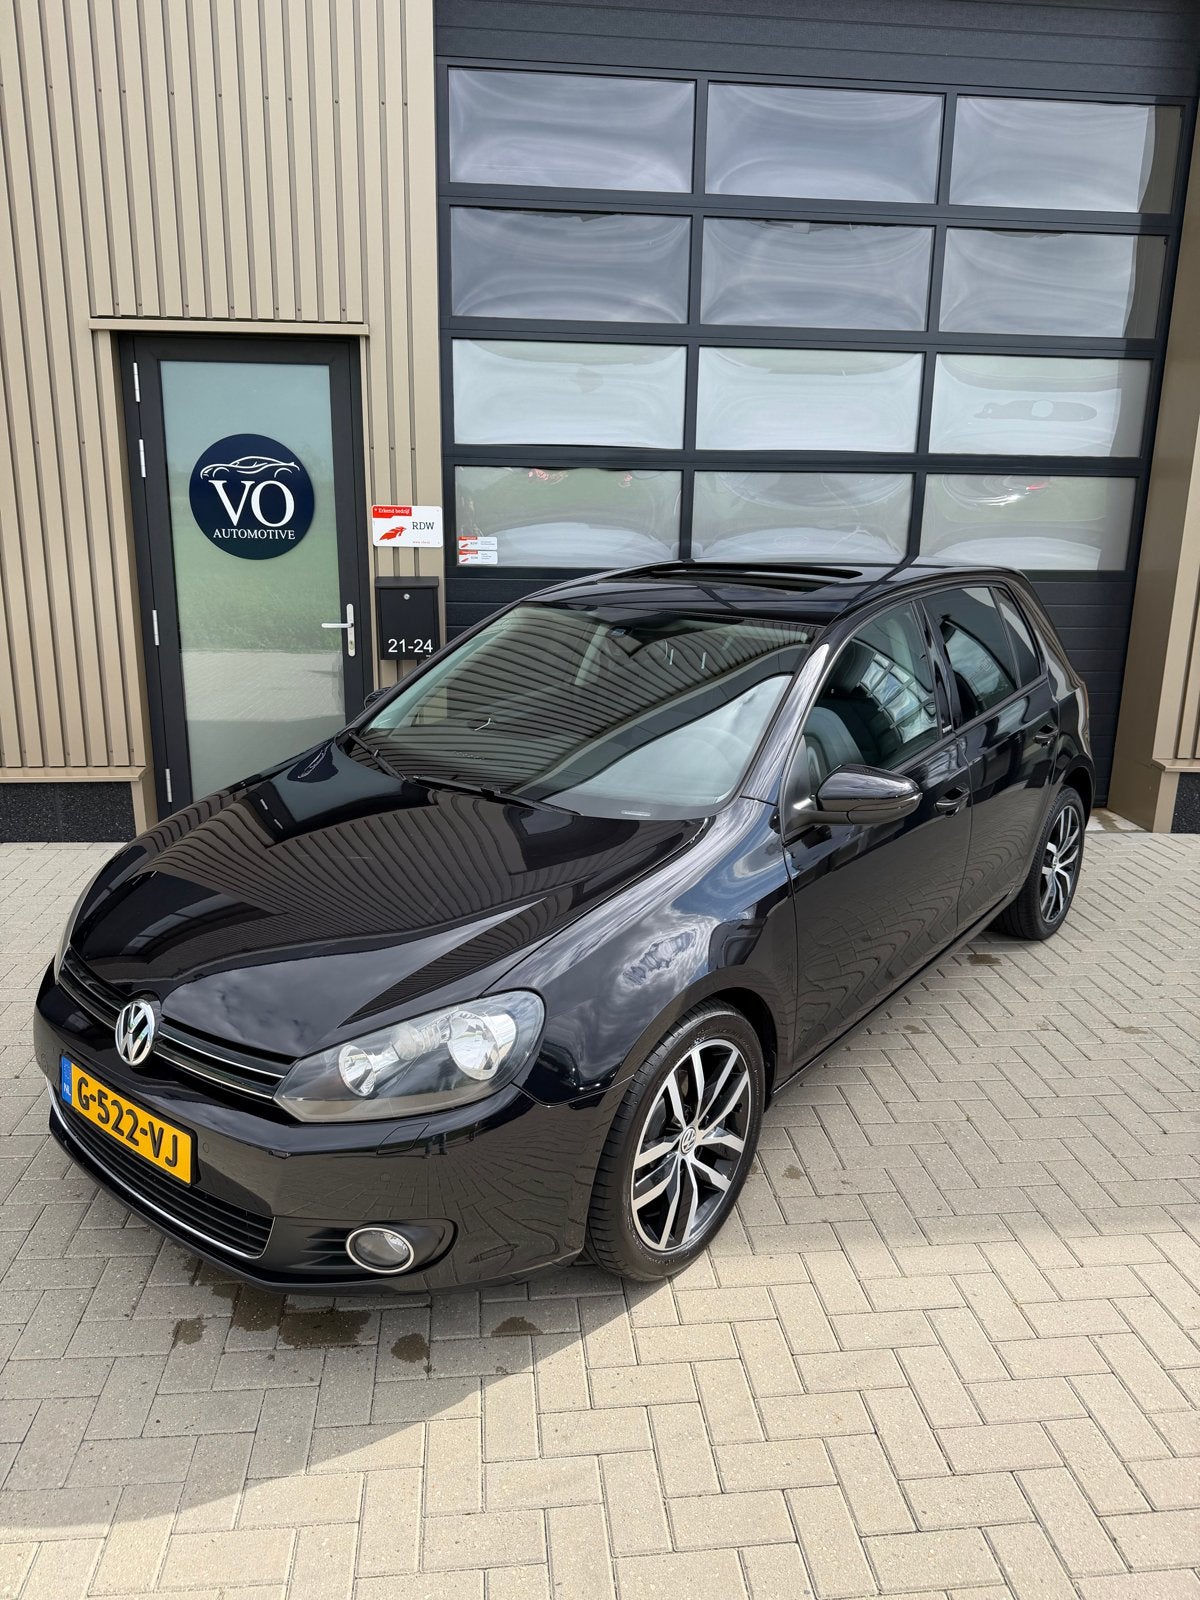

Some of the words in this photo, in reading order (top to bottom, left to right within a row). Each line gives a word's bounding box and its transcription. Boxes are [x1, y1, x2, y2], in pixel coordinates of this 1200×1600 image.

[208, 480, 294, 527] VO
[412, 521, 435, 530] RDW
[213, 528, 296, 540] AUTOMOTIVE
[388, 638, 434, 653] 21-24
[63, 1082, 72, 1097] NL
[78, 1077, 178, 1167] G-522-VJ
